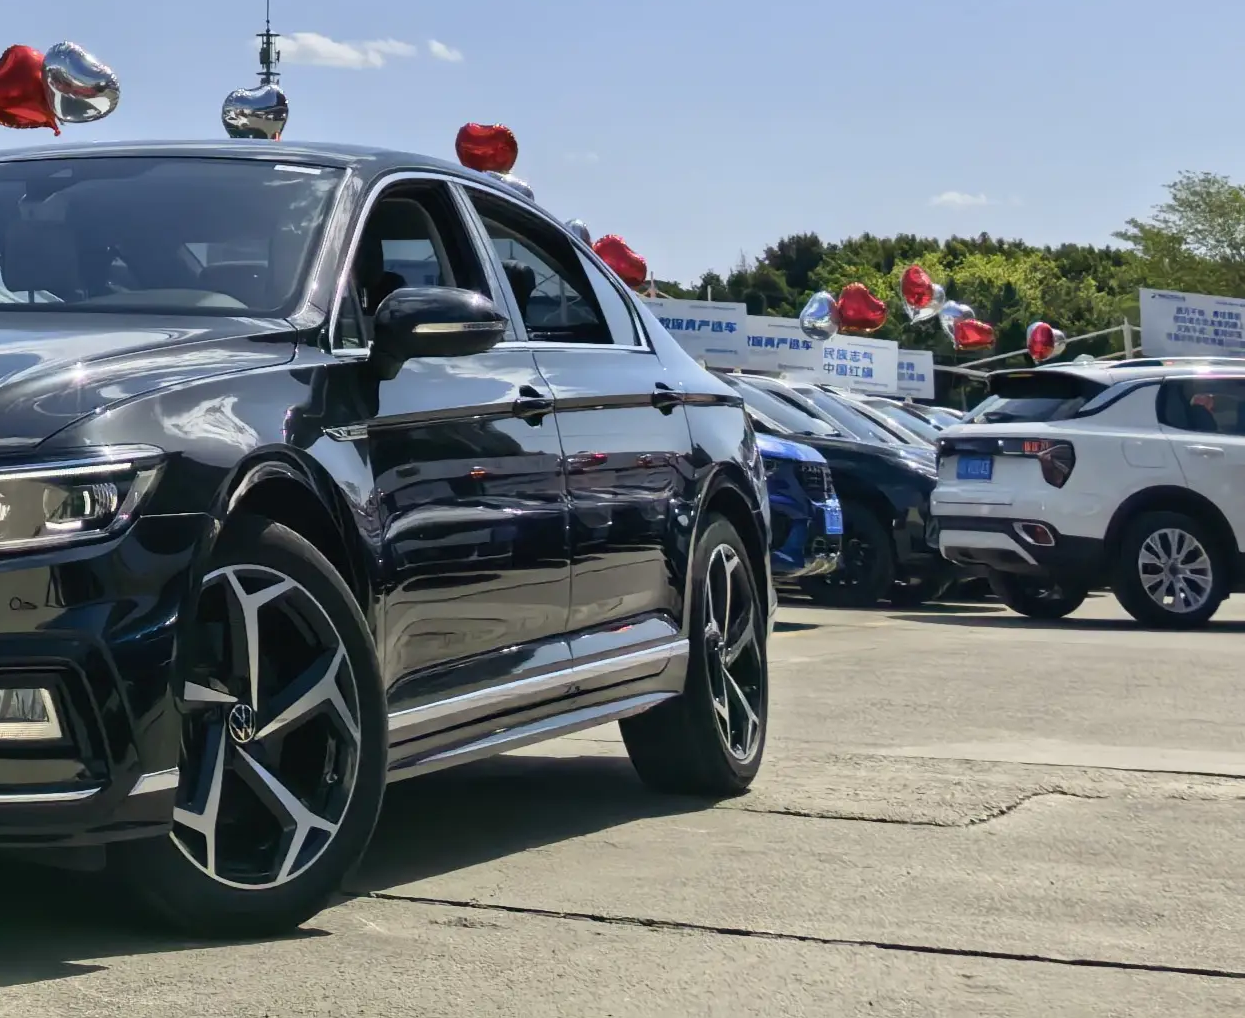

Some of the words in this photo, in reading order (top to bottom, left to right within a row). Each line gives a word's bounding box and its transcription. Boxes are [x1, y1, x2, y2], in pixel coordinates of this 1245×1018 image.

[823, 347, 874, 364] 民族志气
[823, 362, 874, 379] 中国红旗
